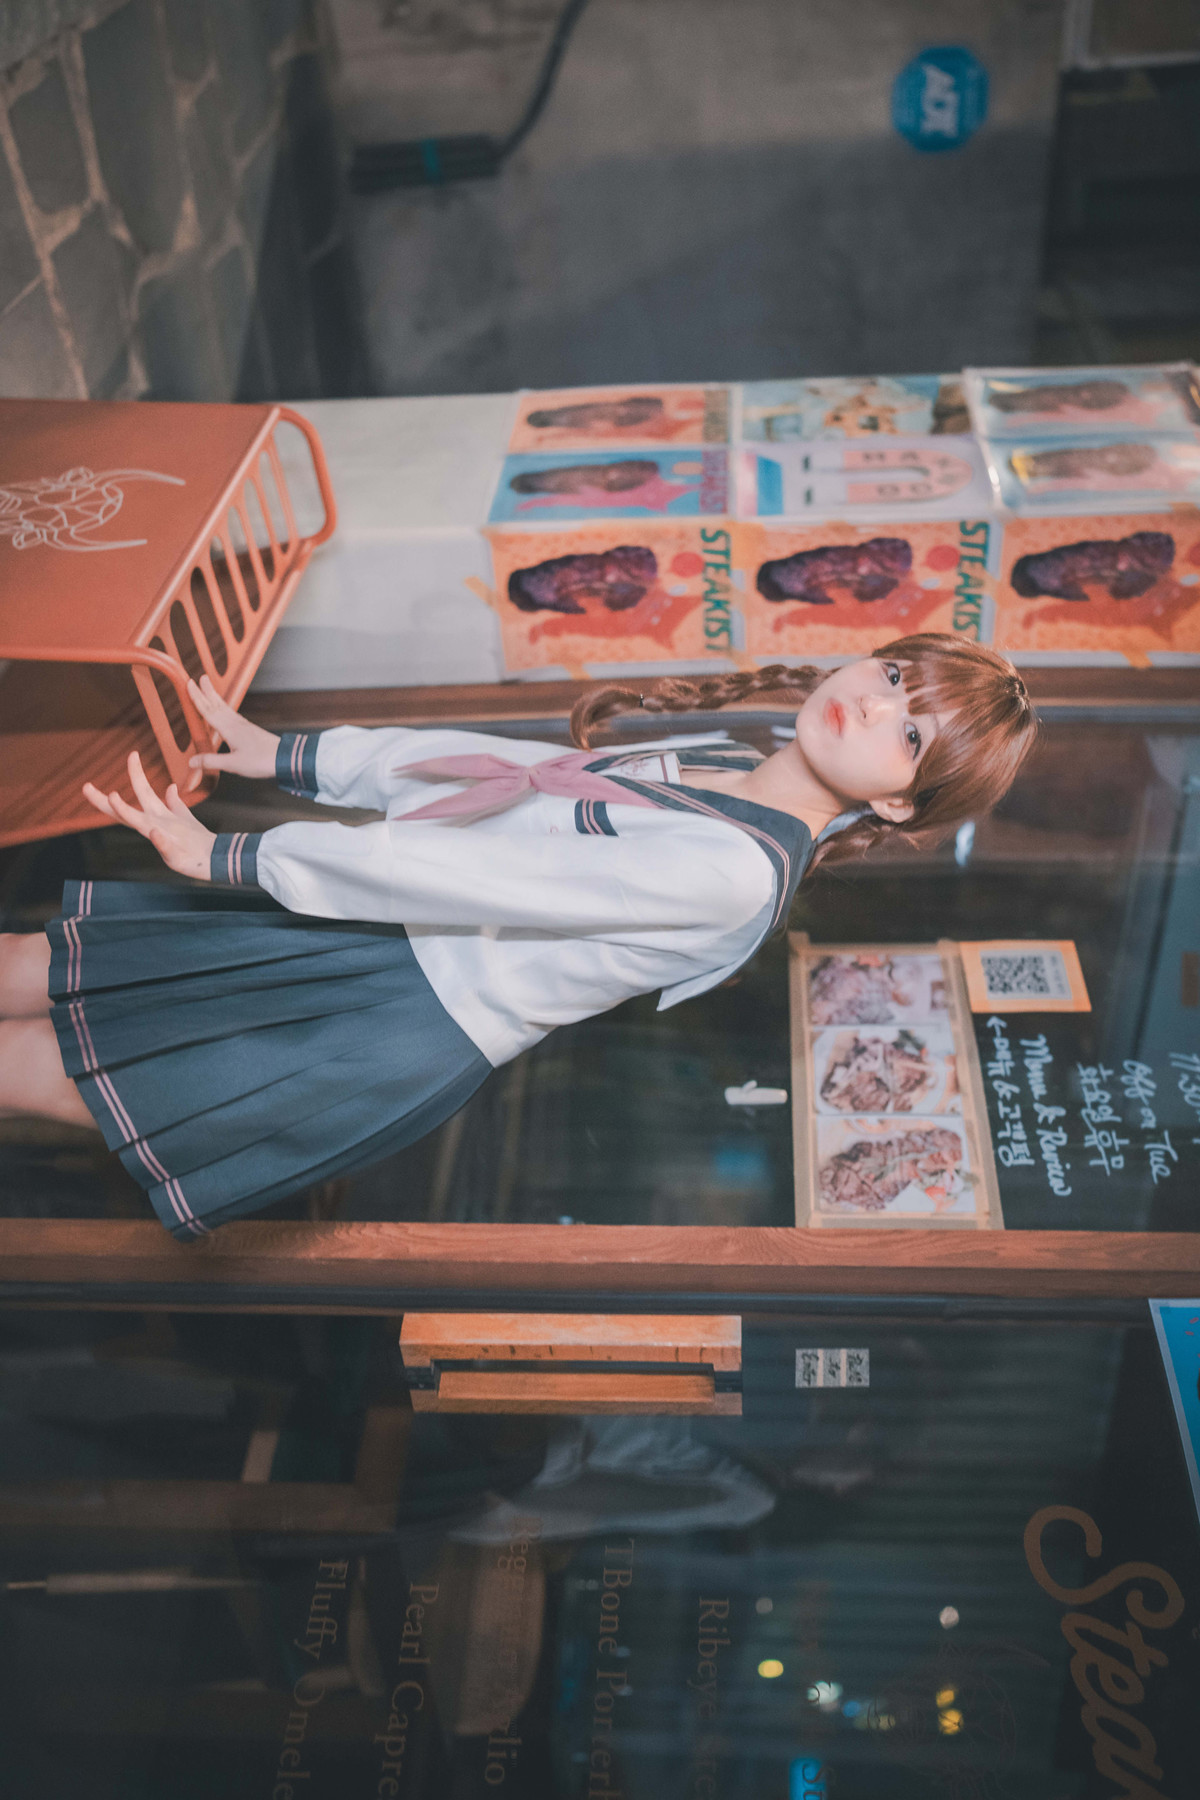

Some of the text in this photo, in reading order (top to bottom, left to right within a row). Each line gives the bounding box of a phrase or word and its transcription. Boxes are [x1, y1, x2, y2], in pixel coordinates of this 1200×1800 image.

[701, 528, 732, 656] STEAKIST
[953, 521, 990, 643] STEAKIS
[1020, 1034, 1053, 1100] Menu
[1121, 1060, 1157, 1105] Off
[1144, 1130, 1178, 1184] Tue
[293, 1559, 349, 1661] Fluffy
[597, 1538, 635, 1655] TBone
[373, 1582, 440, 1800] Pearl Capre
[686, 1597, 731, 1720] Ribeye
